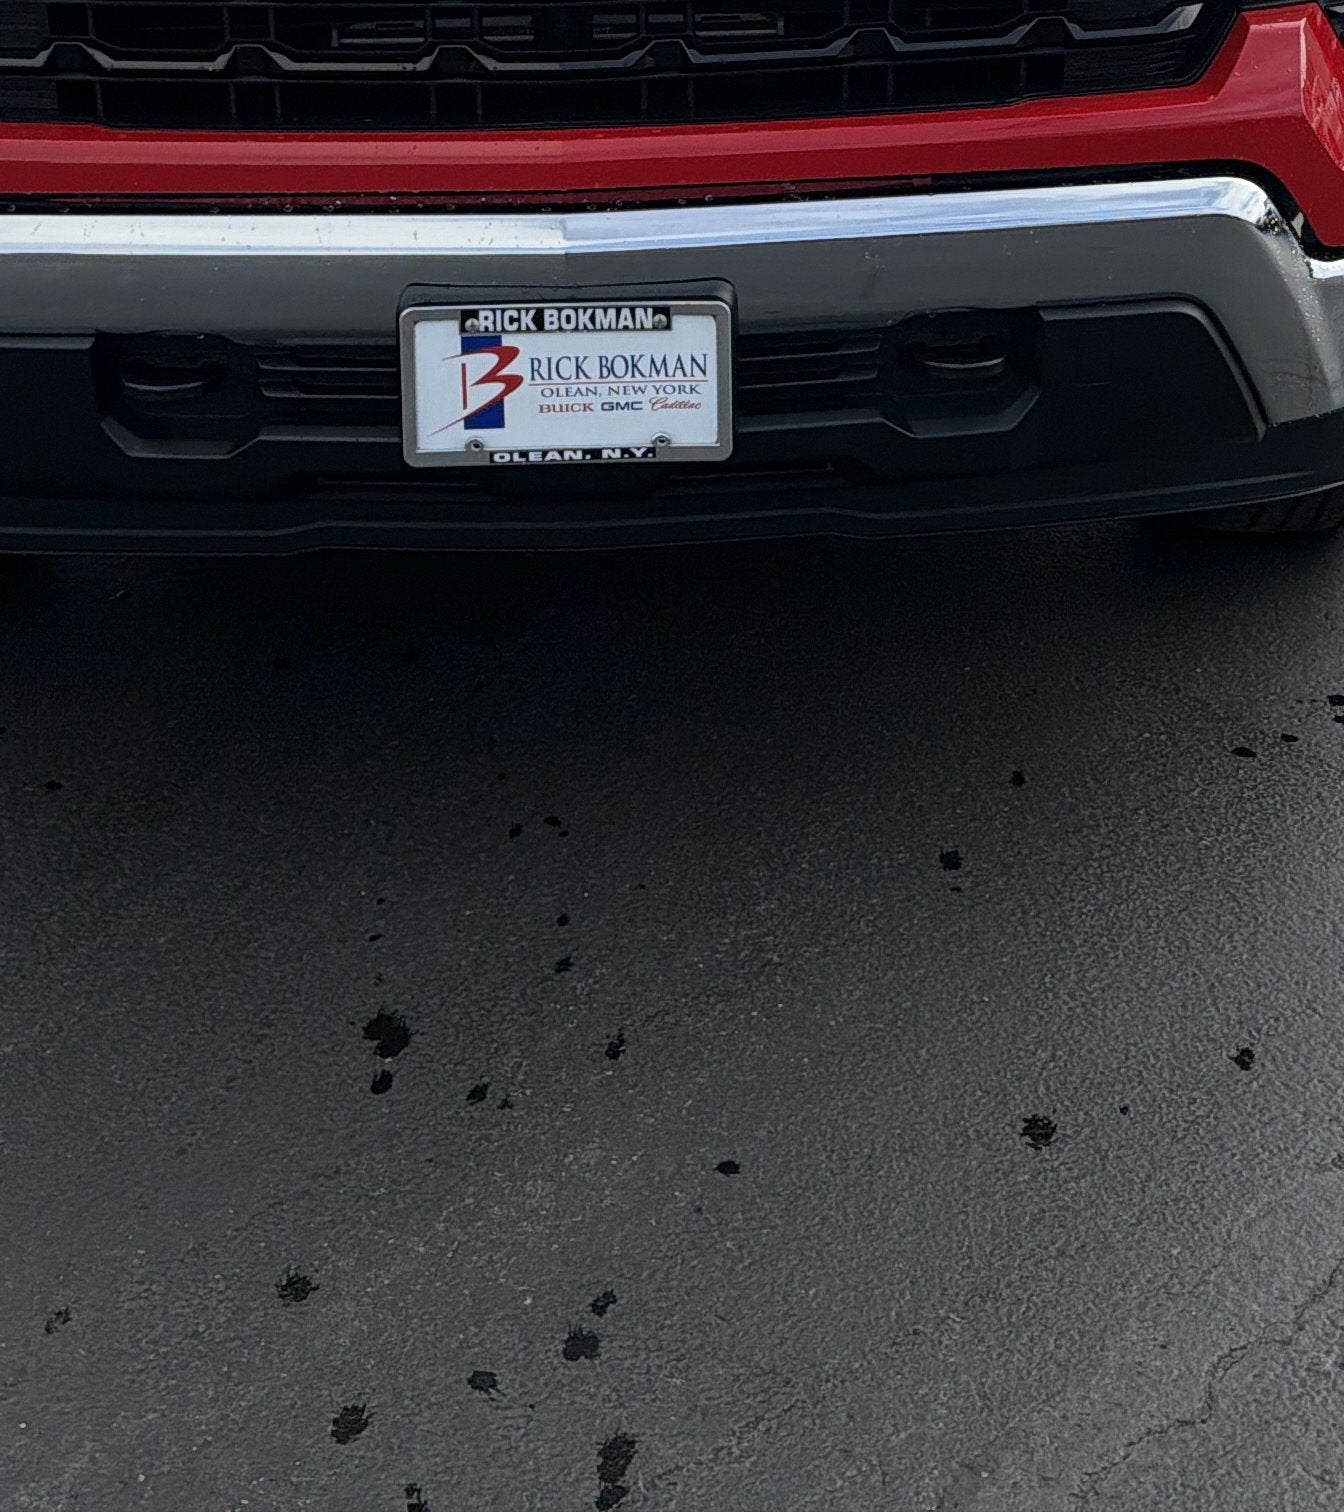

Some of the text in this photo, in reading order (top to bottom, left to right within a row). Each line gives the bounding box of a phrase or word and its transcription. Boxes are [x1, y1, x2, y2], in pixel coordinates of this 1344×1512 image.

[477, 307, 654, 332] RICK BOKMAN
[529, 352, 709, 381] RICK BOKMAN
[540, 383, 703, 399] OLEAN, NEW YORK
[538, 396, 703, 414] BUICK GMC Cadillac
[602, 447, 655, 460] N.Y.
